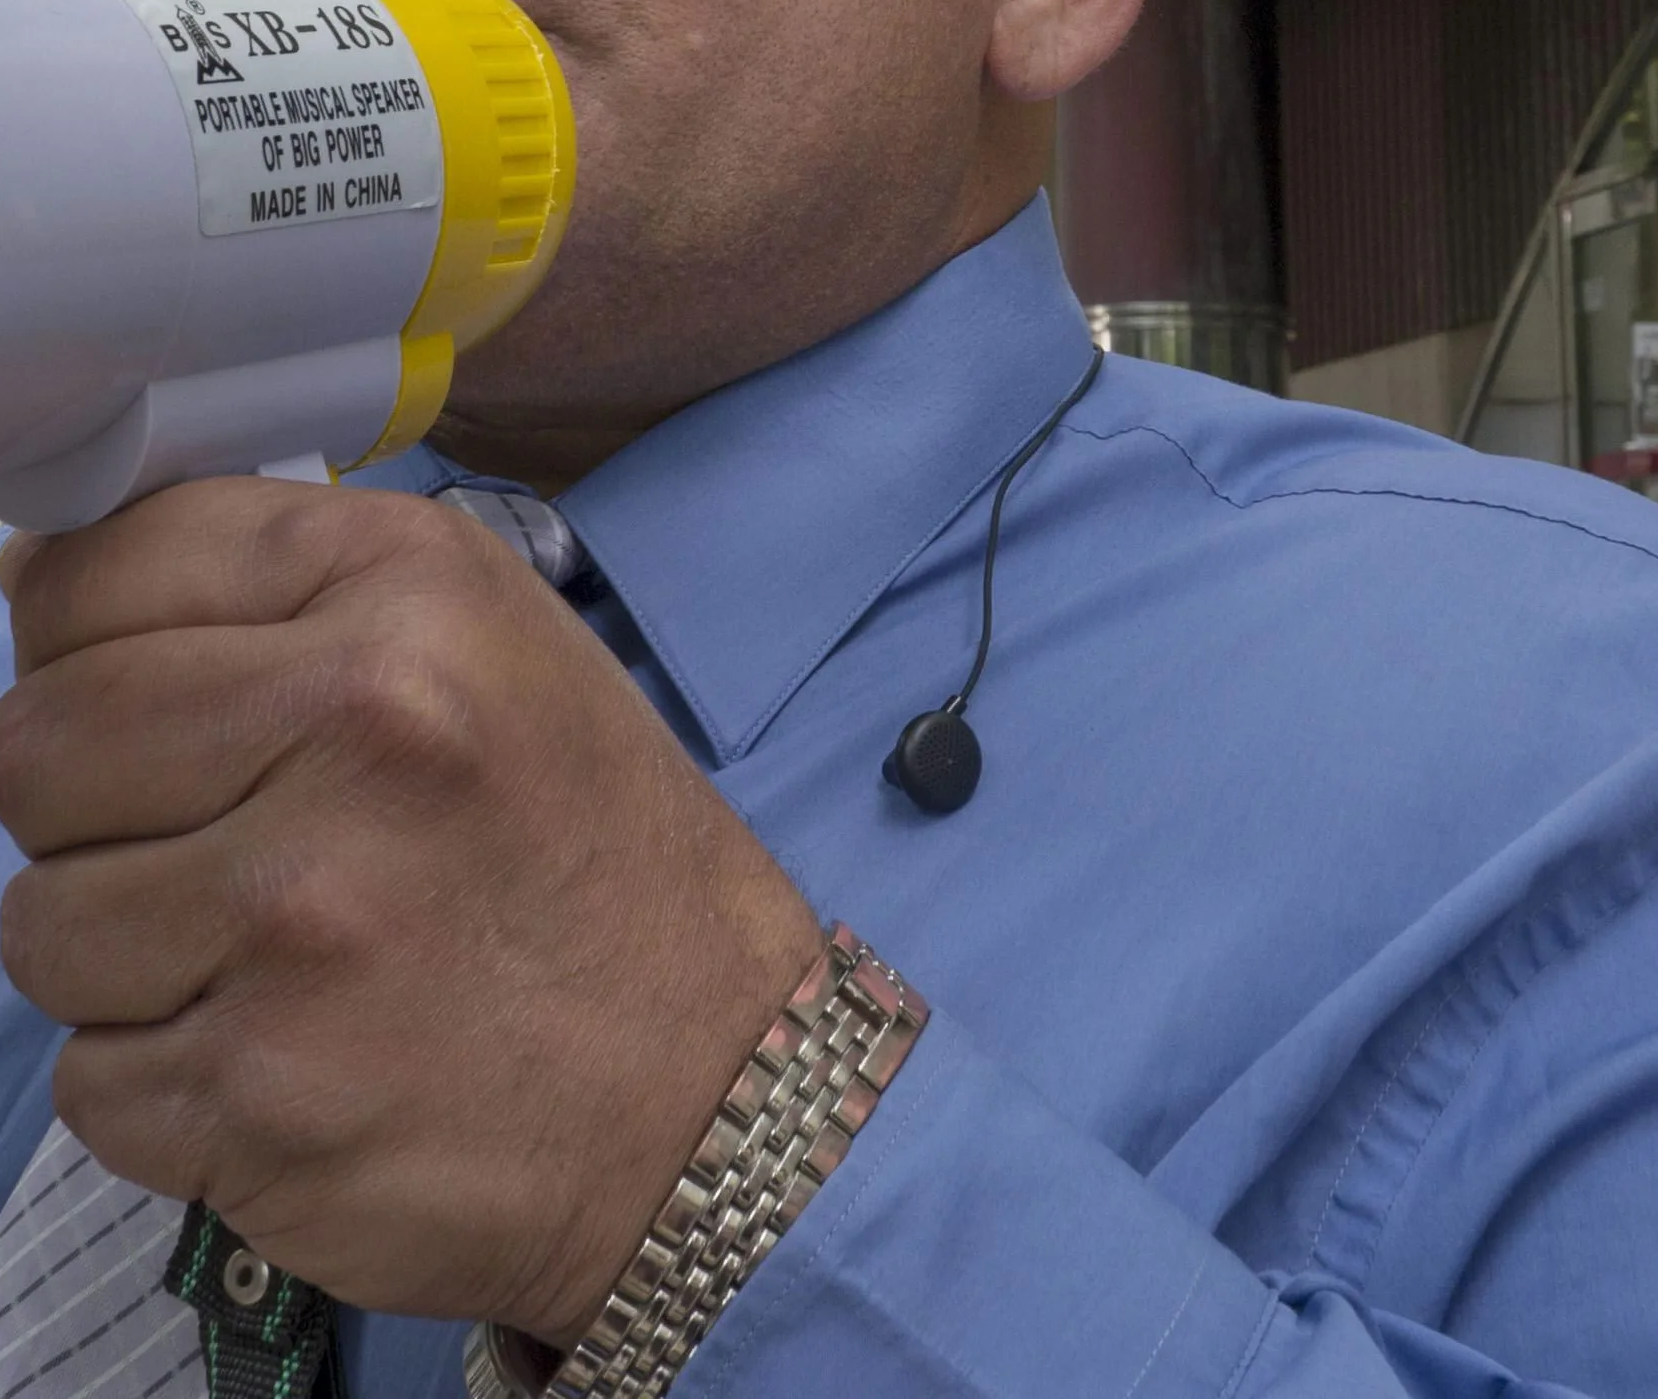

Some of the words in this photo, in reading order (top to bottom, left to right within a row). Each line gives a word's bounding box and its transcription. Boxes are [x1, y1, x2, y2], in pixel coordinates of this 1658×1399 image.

[223, 3, 394, 57] XB-18S
[194, 91, 285, 134] PORTABLE
[281, 85, 355, 124] MUSICAL
[351, 77, 425, 117] SPEAKER
[261, 134, 284, 172] OF
[290, 131, 321, 168] BIG
[326, 123, 385, 164] POWER
[250, 186, 307, 222] MADE
[316, 181, 335, 213] IN
[344, 172, 402, 209] CHINA
